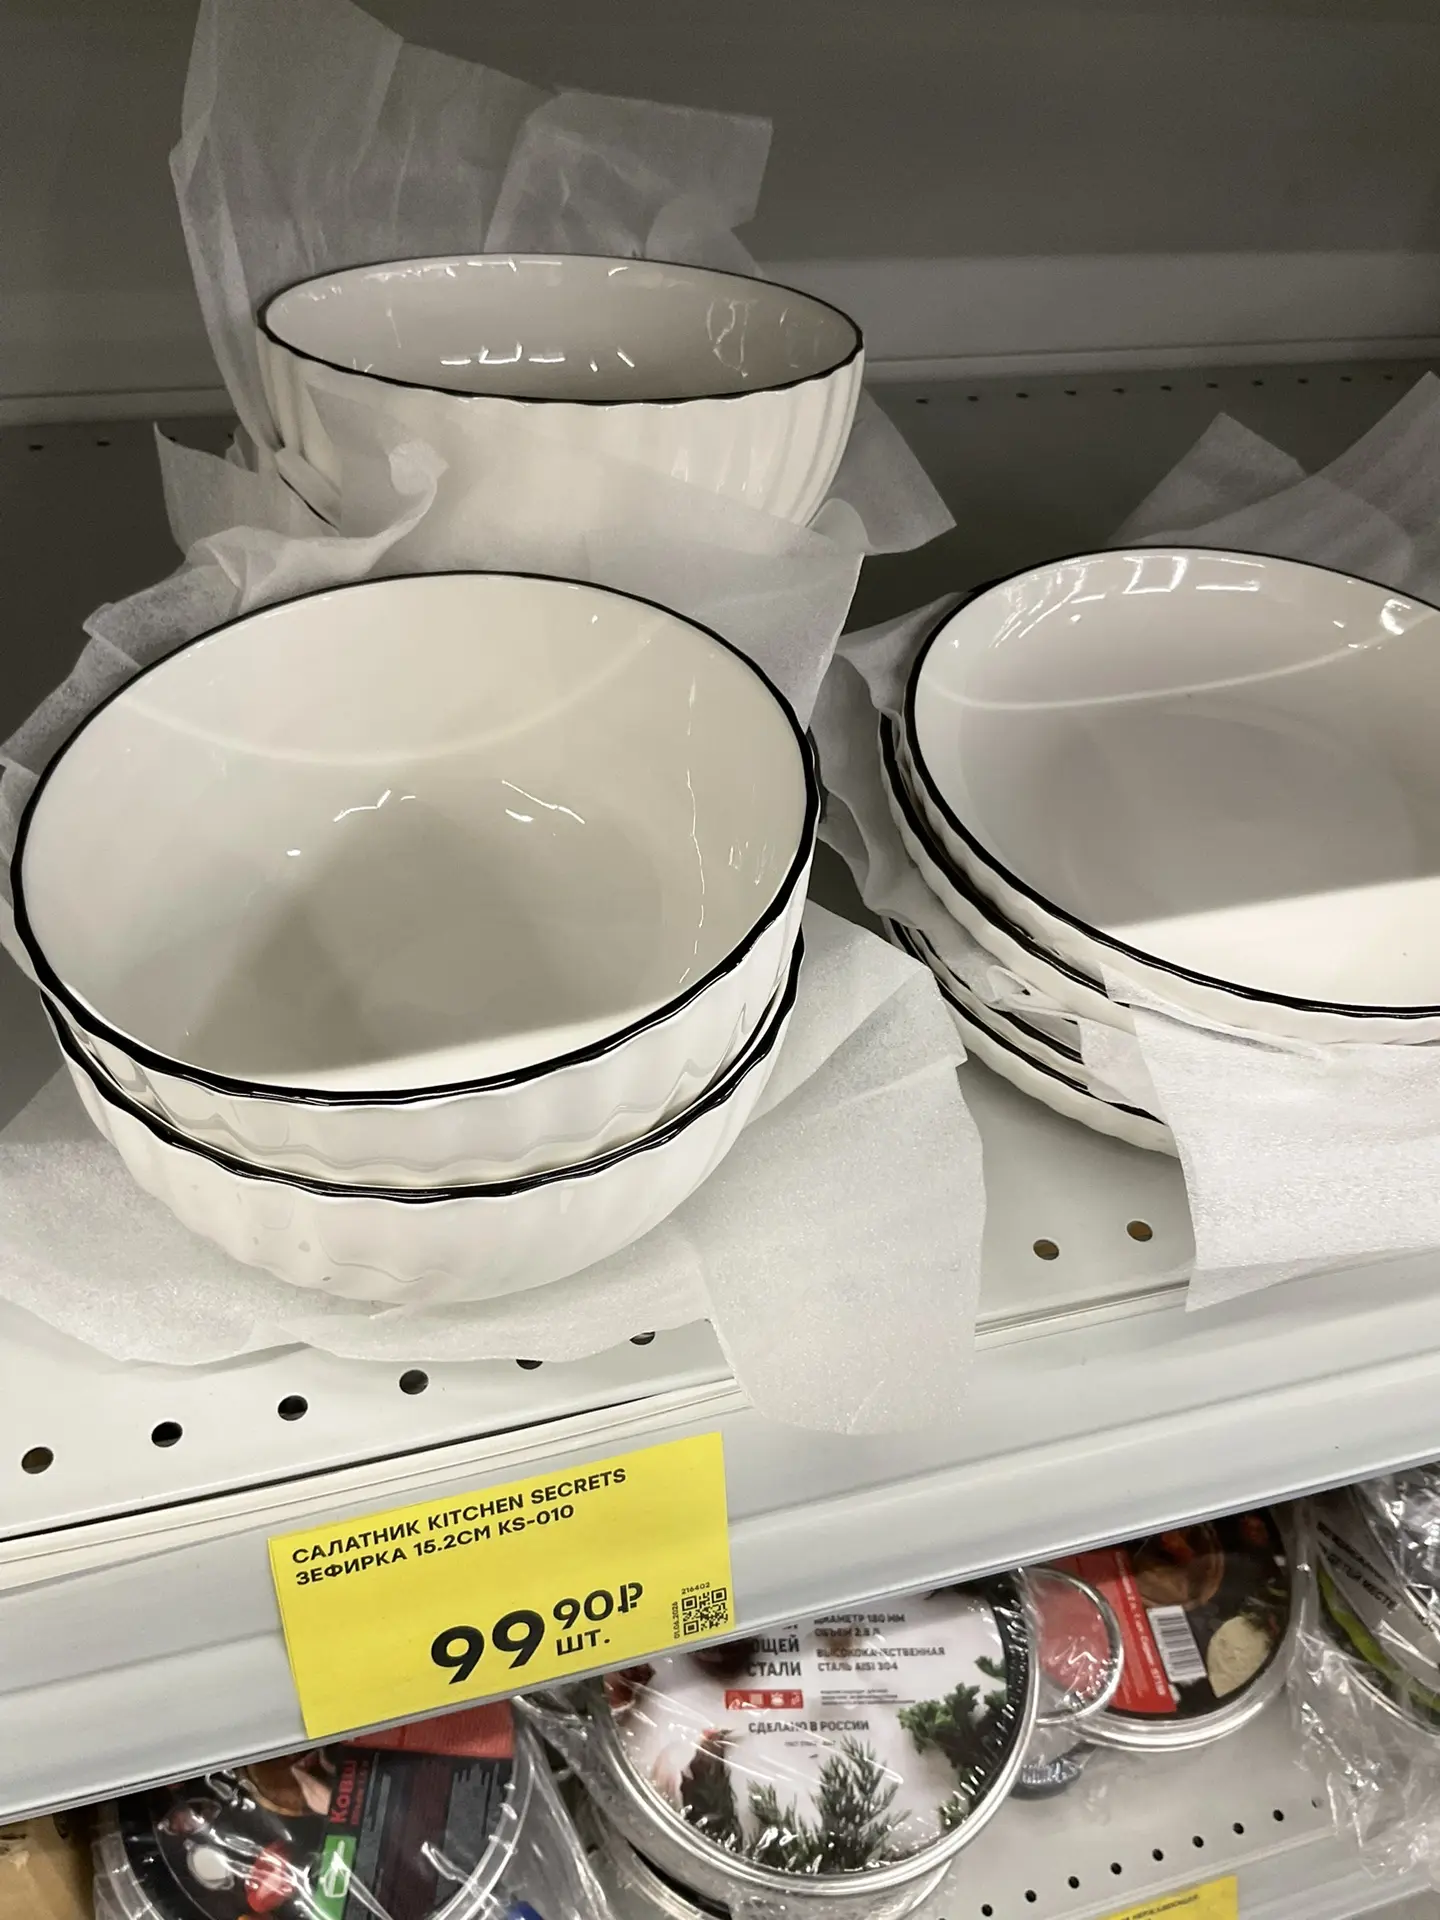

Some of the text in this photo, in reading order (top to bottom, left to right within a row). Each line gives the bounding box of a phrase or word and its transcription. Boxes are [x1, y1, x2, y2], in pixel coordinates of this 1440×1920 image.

[292, 1468, 627, 1565] САЛАТНИК KITCHEN SECRETS
[295, 1504, 575, 1586] ЗЕФИРКА 15.2СМ KS-010
[681, 1581, 711, 1595] 216402
[430, 1609, 546, 1685] 99
[556, 1628, 611, 1657] ШТ.
[747, 1661, 802, 1678] СТАЛИ
[817, 1661, 853, 1673] СТАЛЬ
[748, 1719, 870, 1735] СДЕЛАНО В РОССИИ
